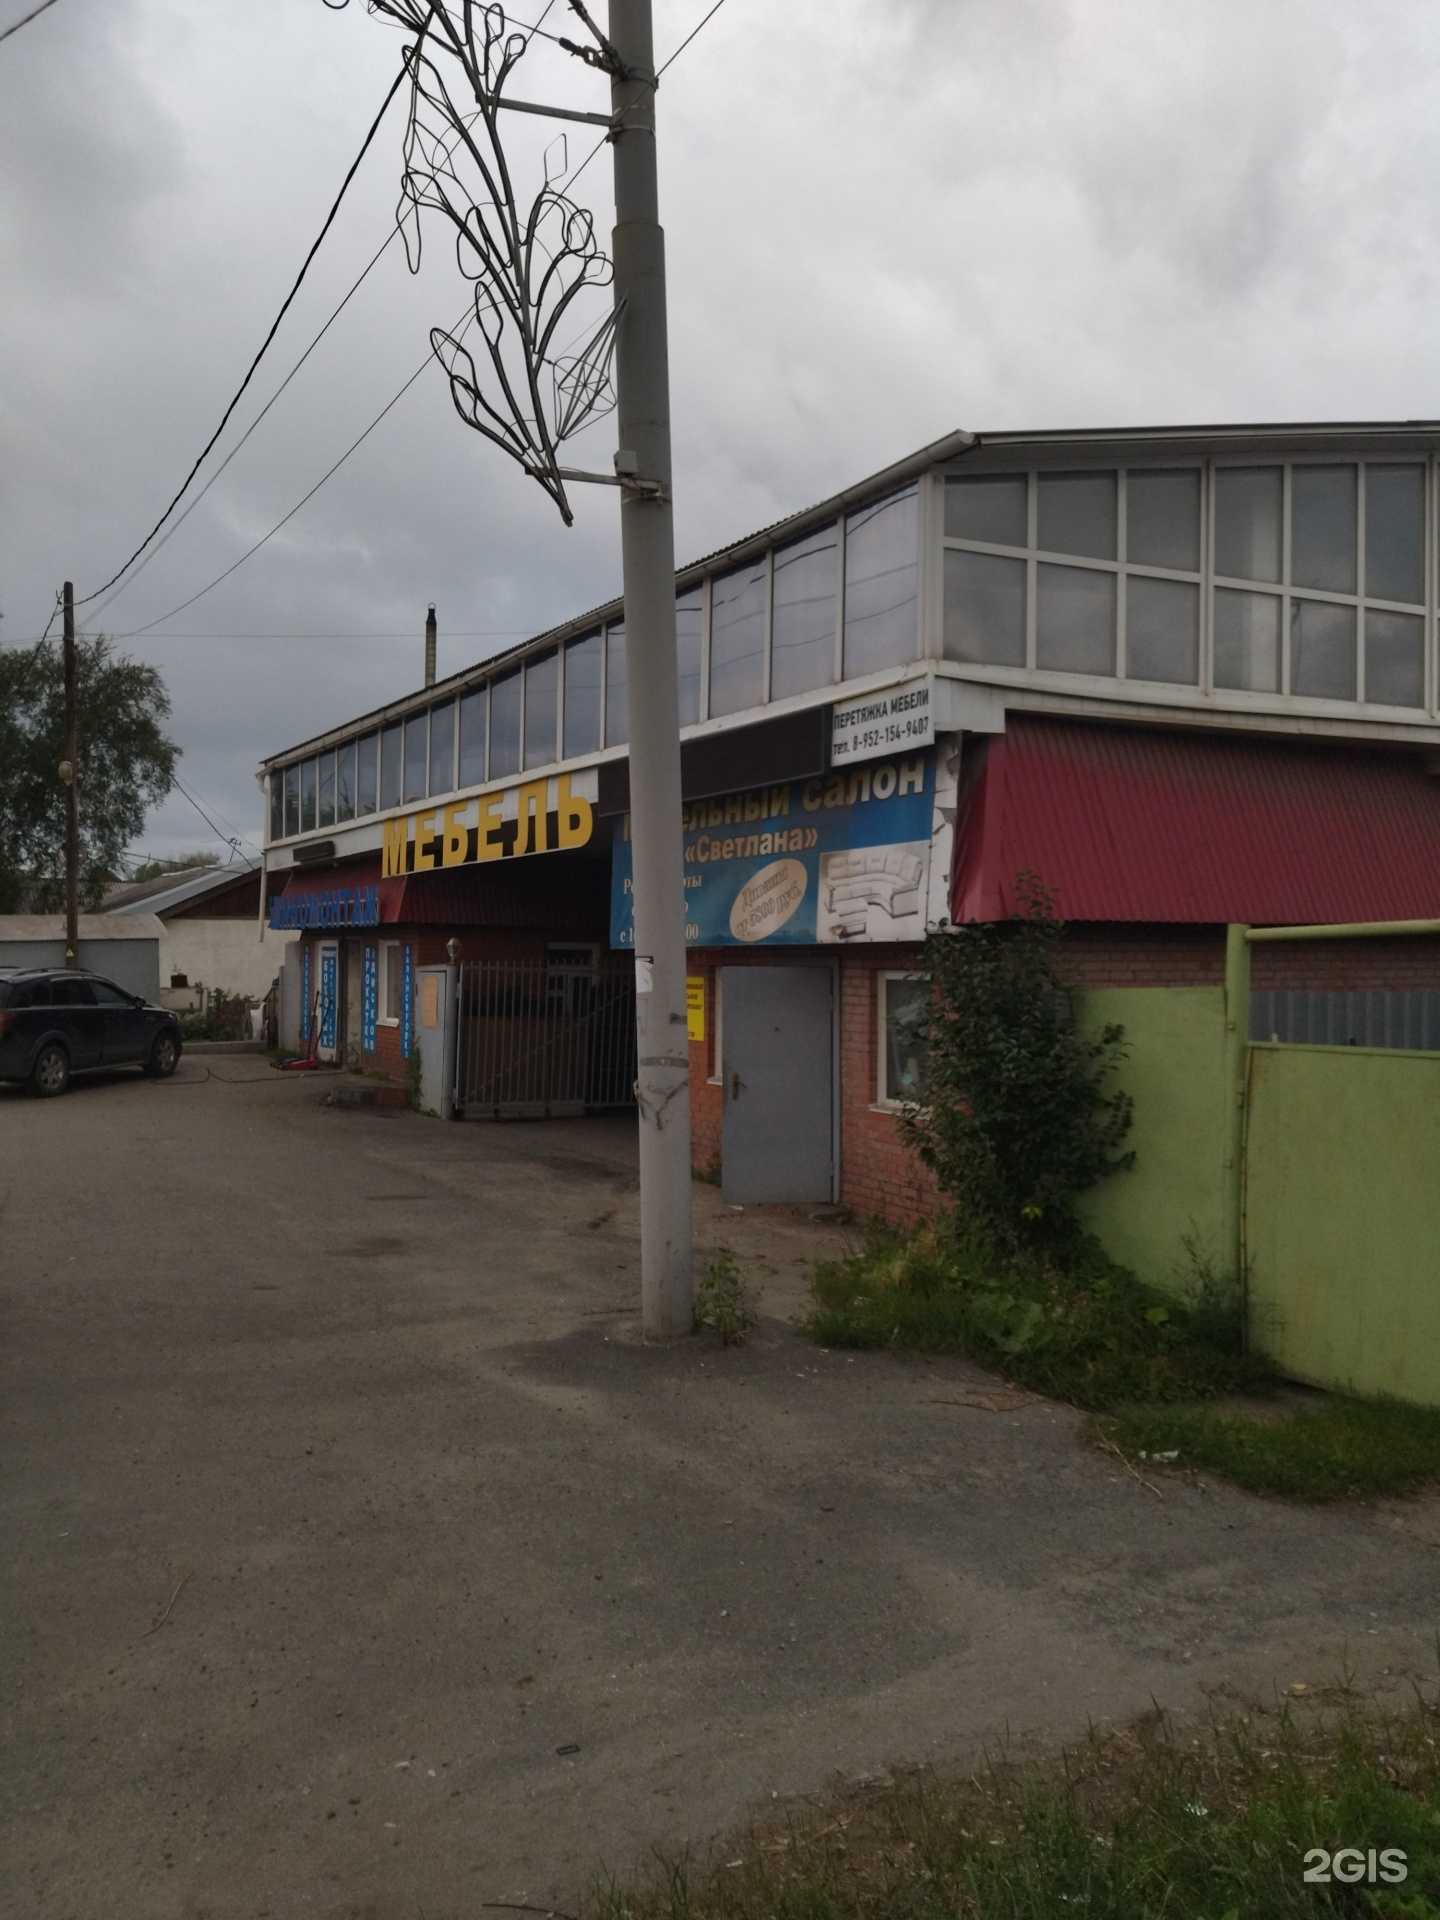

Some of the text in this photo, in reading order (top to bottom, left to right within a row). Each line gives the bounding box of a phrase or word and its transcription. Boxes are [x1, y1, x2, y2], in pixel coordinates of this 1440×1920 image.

[833, 688, 929, 730] ПЕРЕТЯЖКА МЕБЕЛИ
[382, 773, 594, 879] МЕБЕЛЬ
[685, 828, 819, 863] «Светлана»
